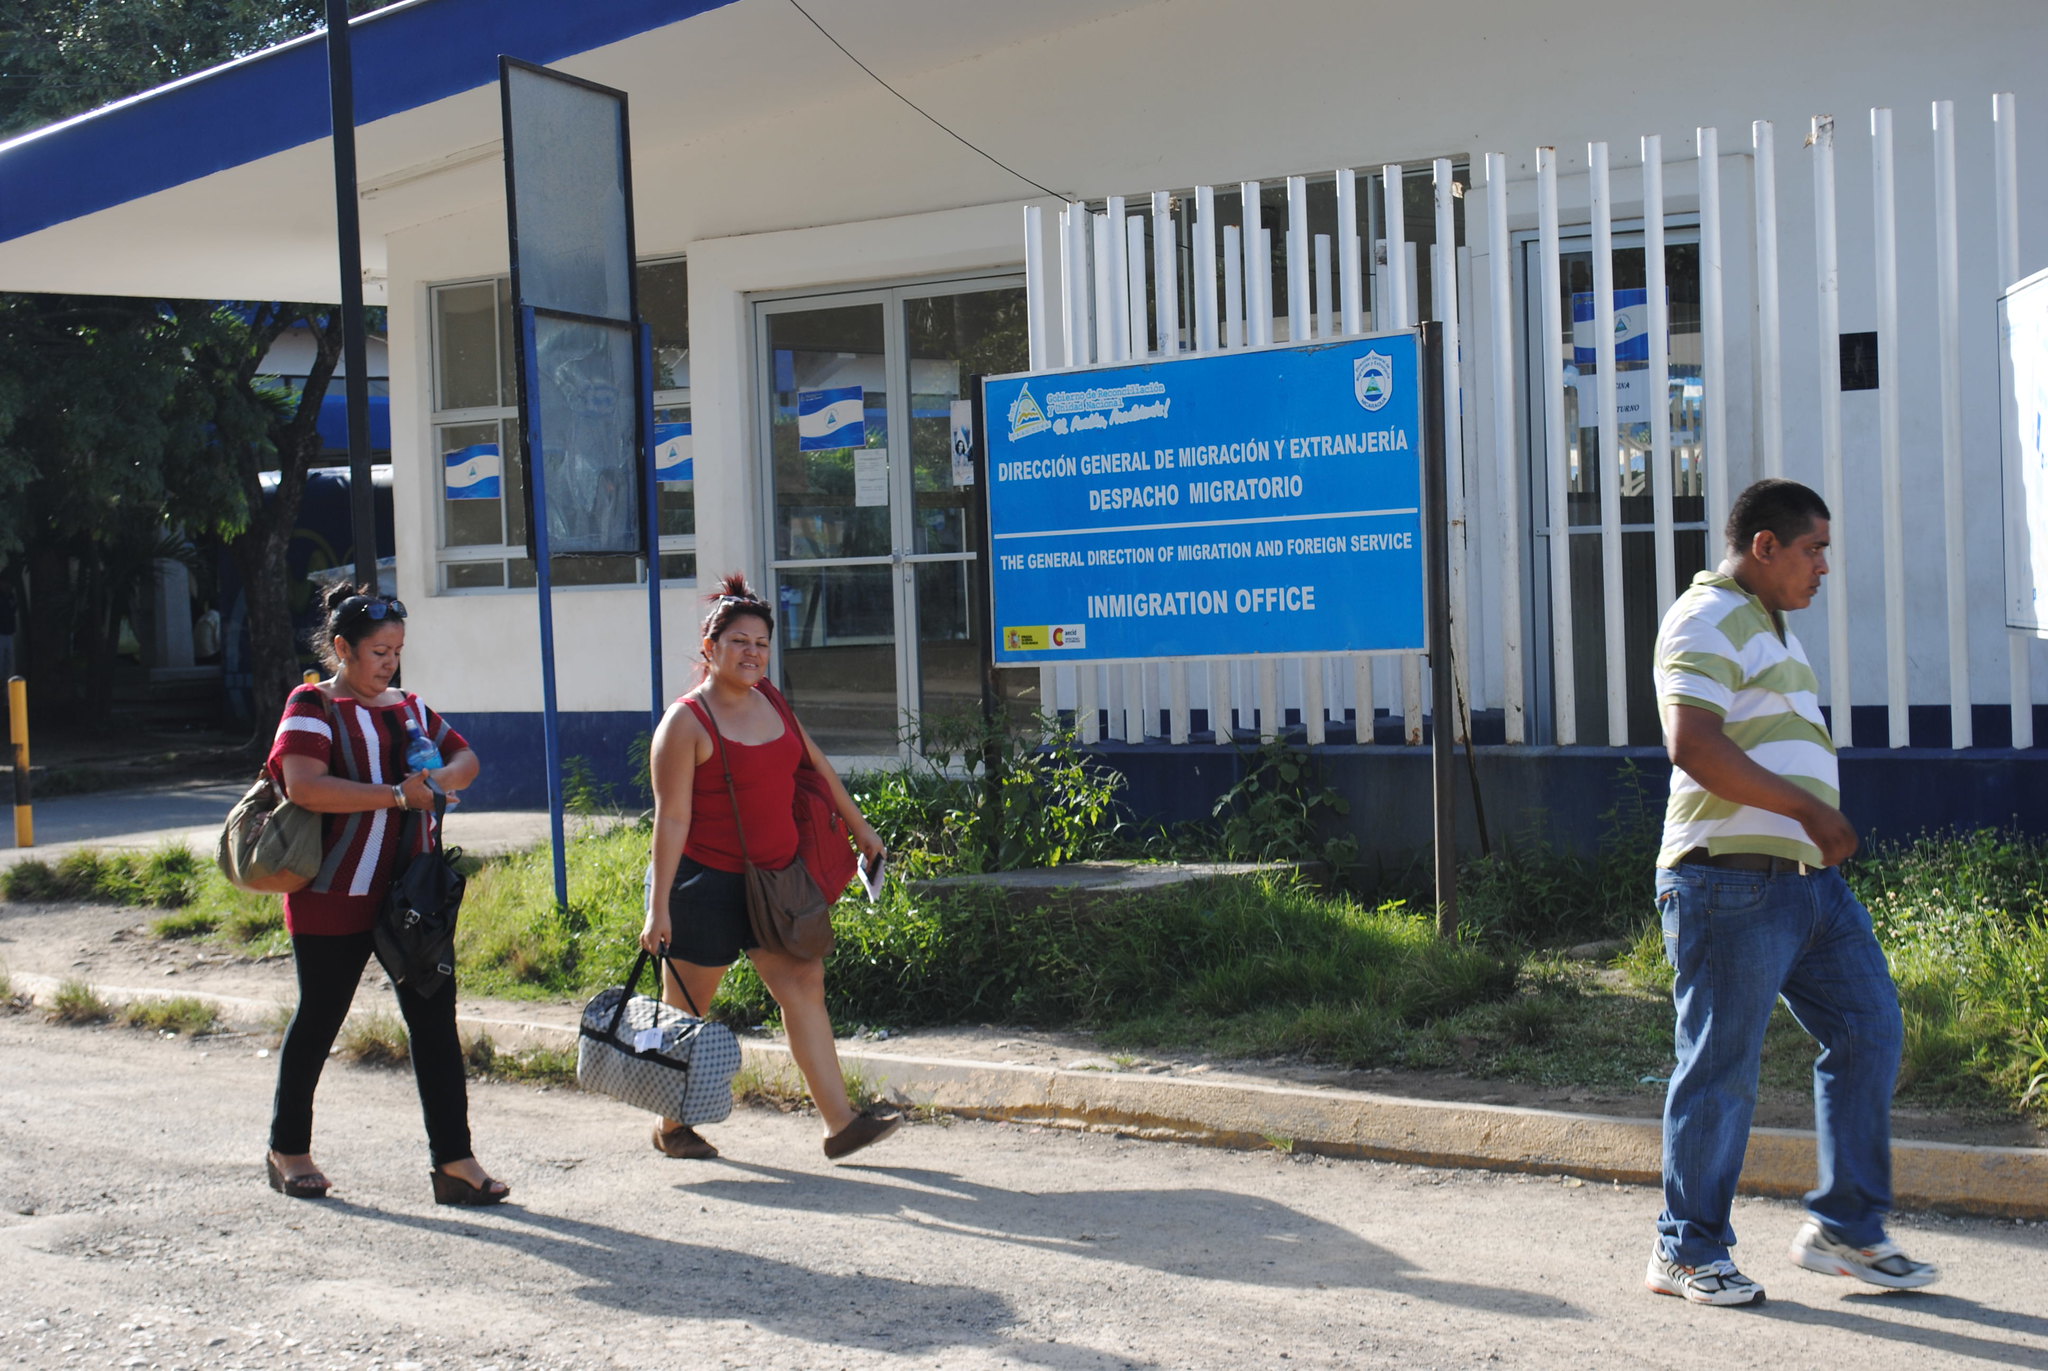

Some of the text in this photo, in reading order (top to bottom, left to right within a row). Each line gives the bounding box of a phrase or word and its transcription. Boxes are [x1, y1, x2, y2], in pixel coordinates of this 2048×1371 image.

[1046, 382, 1165, 404] Gobierno de Reconciliación
[1047, 397, 1124, 417] y Unidad Nacional
[998, 454, 1077, 482] DIRECCIÓN
[1081, 451, 1150, 475] GENERAL
[1154, 449, 1175, 470] DE
[1178, 438, 1270, 468] MIGRACIÓN
[1274, 440, 1286, 460] Y
[1290, 425, 1408, 459] EXTRANJERÍA
[1089, 475, 1303, 511] DESPACHO MIGRATORIO
[1001, 532, 1413, 570] THE GENERAL DIRECTION OF MIGRATION AND FOREIGN SERVICE
[1088, 586, 1316, 619] INMIGRATION OFFICE
